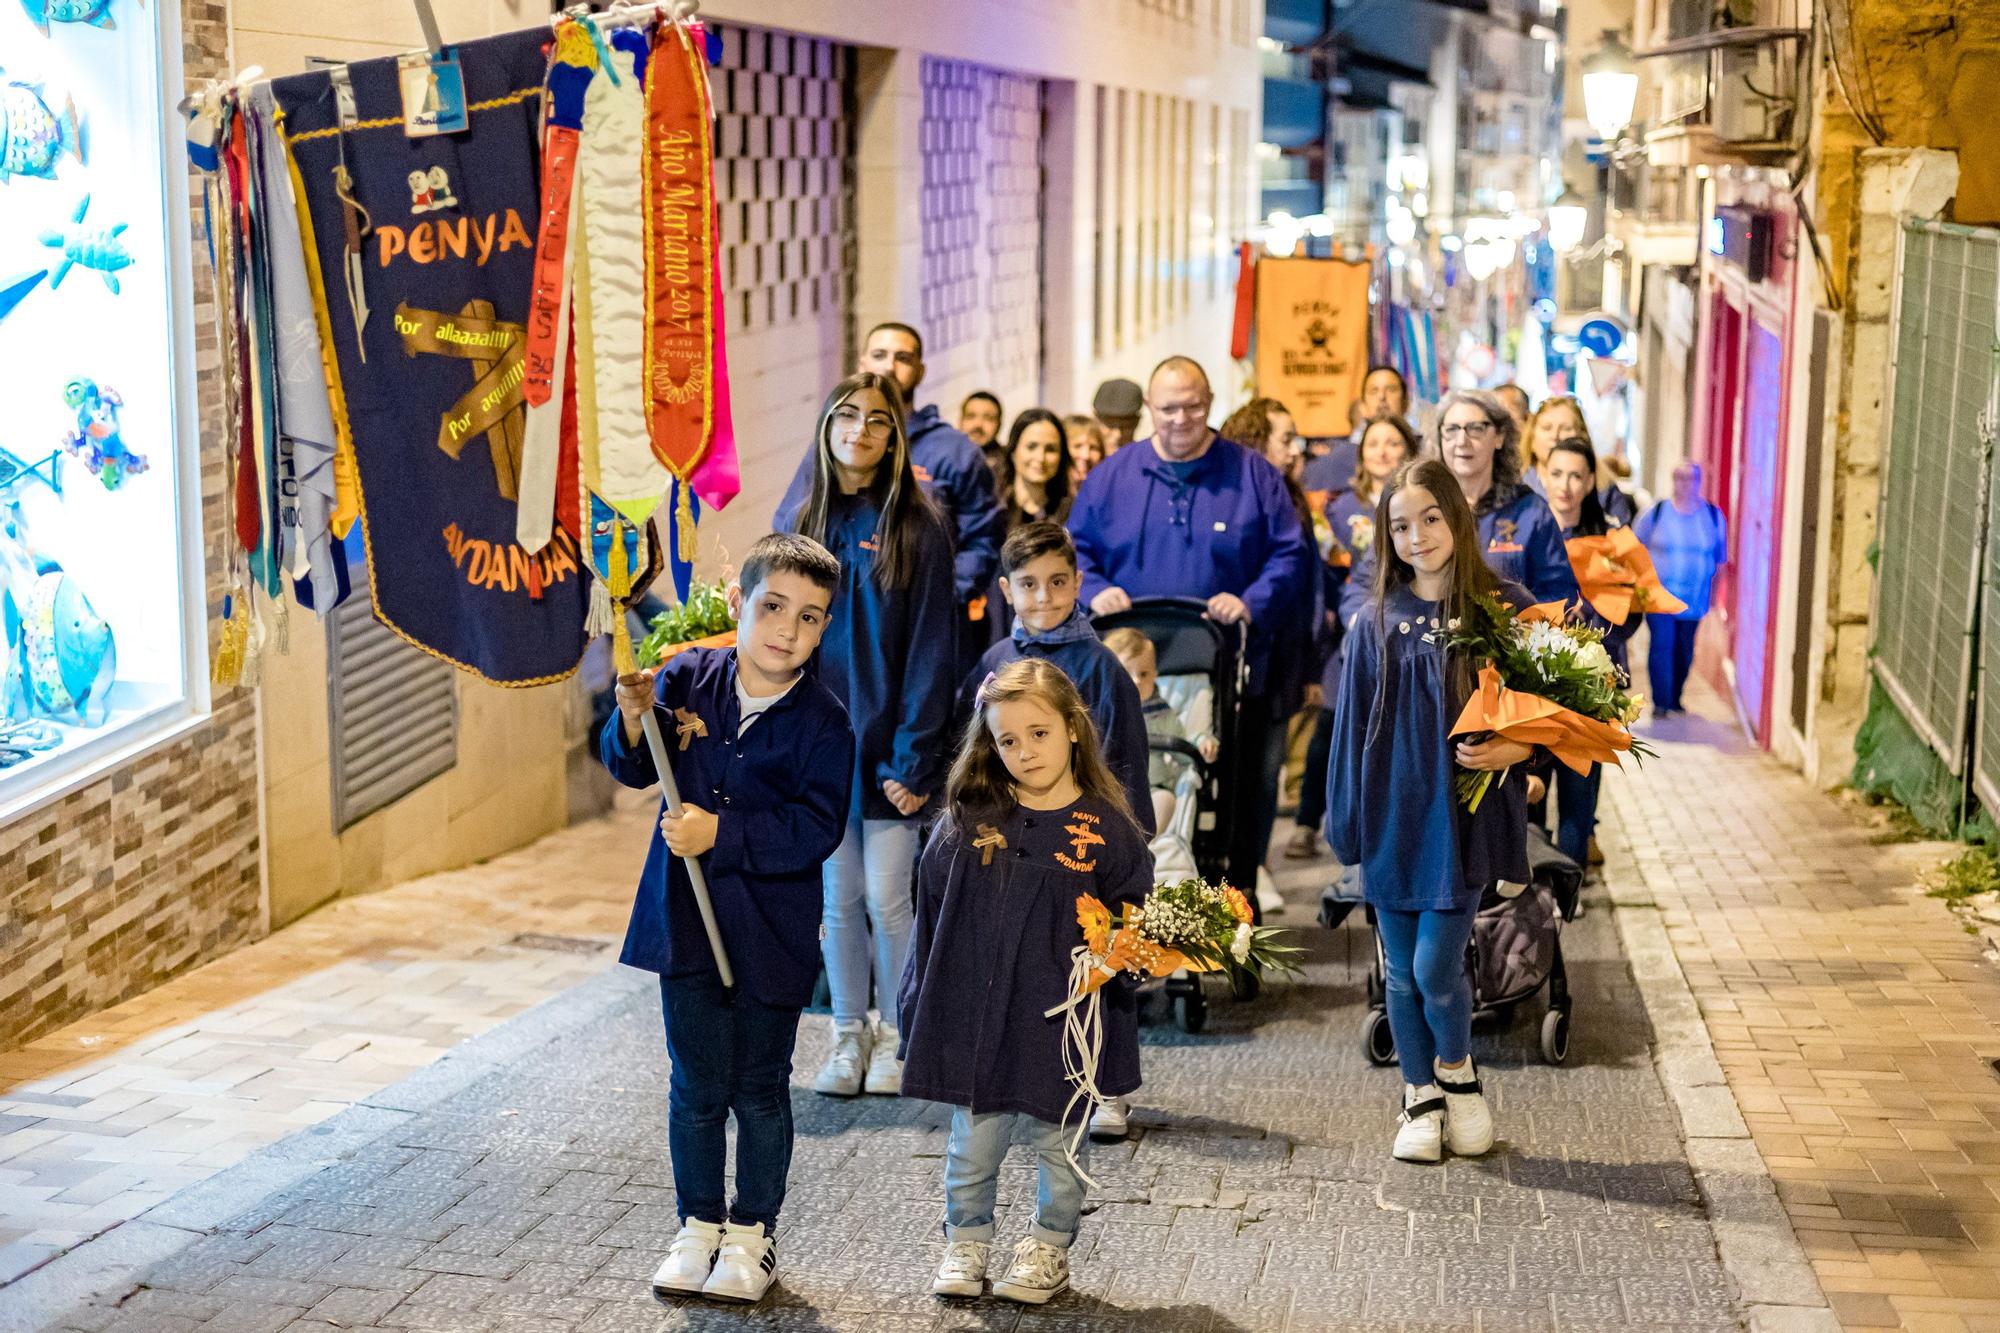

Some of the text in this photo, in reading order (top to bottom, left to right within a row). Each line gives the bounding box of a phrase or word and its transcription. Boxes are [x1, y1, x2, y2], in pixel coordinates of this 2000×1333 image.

[375, 208, 533, 268] PENYA
[659, 124, 697, 332] Año Mariano 2017
[394, 314, 422, 335] Por
[448, 412, 470, 440] Por
[1071, 811, 1100, 824] PENYA
